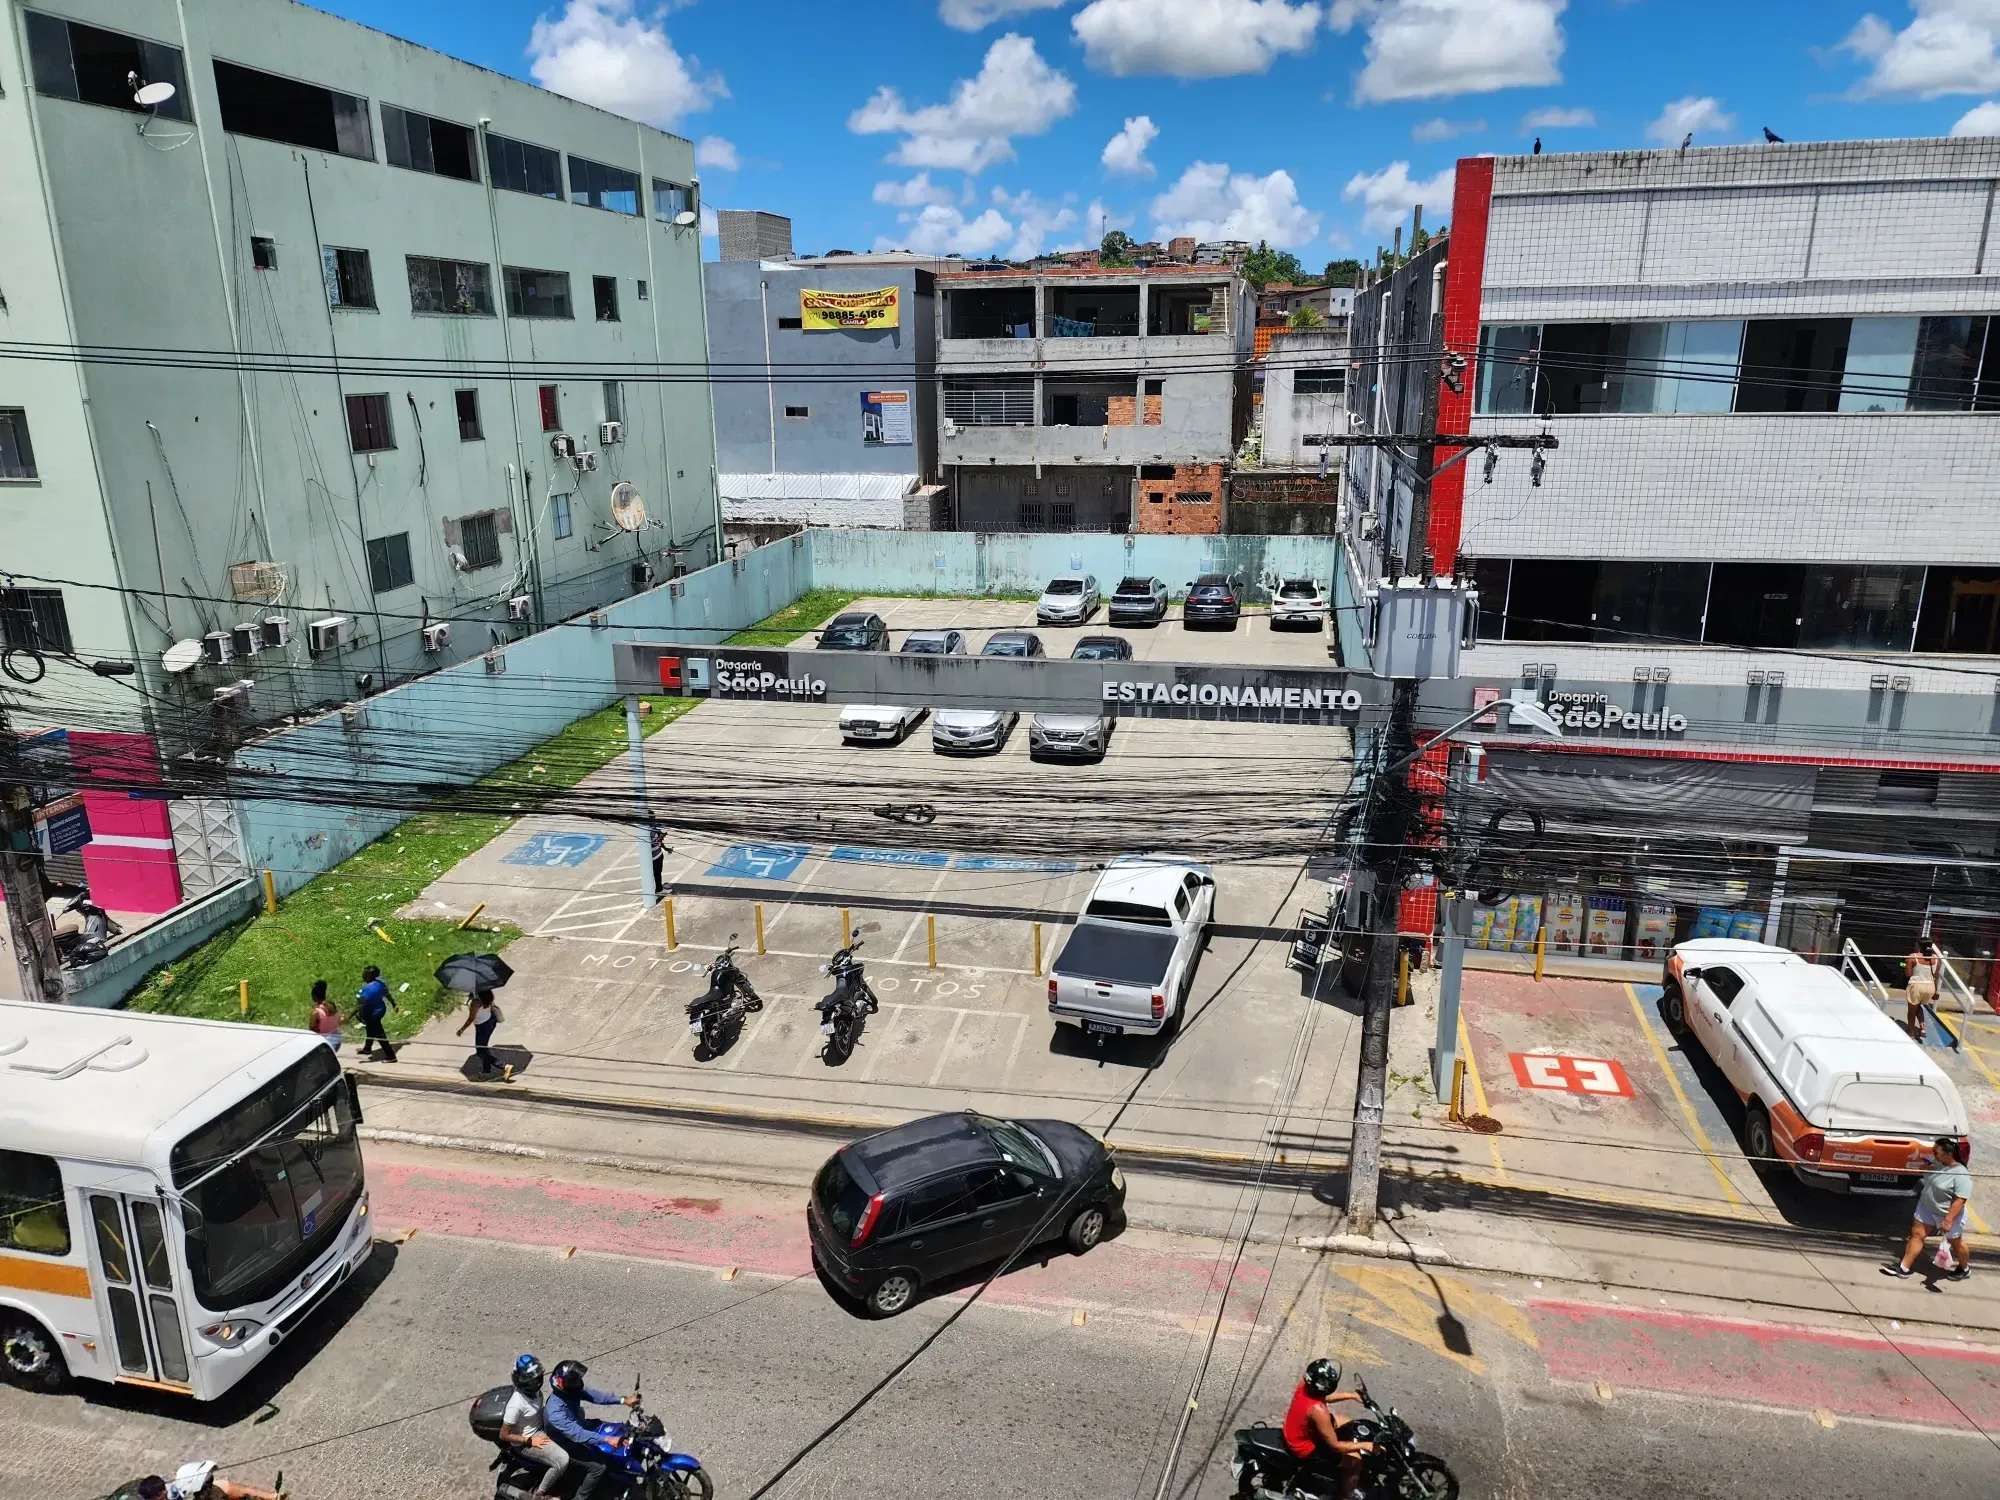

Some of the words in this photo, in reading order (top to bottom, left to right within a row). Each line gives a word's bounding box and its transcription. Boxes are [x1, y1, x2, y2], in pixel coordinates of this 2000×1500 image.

[806, 299, 832, 308] SALA
[834, 296, 894, 307] COMERCIAL
[821, 309, 885, 320] 98885-4186
[715, 658, 762, 672] Drogaria
[716, 671, 827, 696] SãoPaulo
[1102, 681, 1363, 711] ESTACIONAMENTO
[1549, 689, 1609, 705] Drogaria
[1547, 703, 1688, 732] SãoPaulo
[580, 953, 706, 978] MOTO
